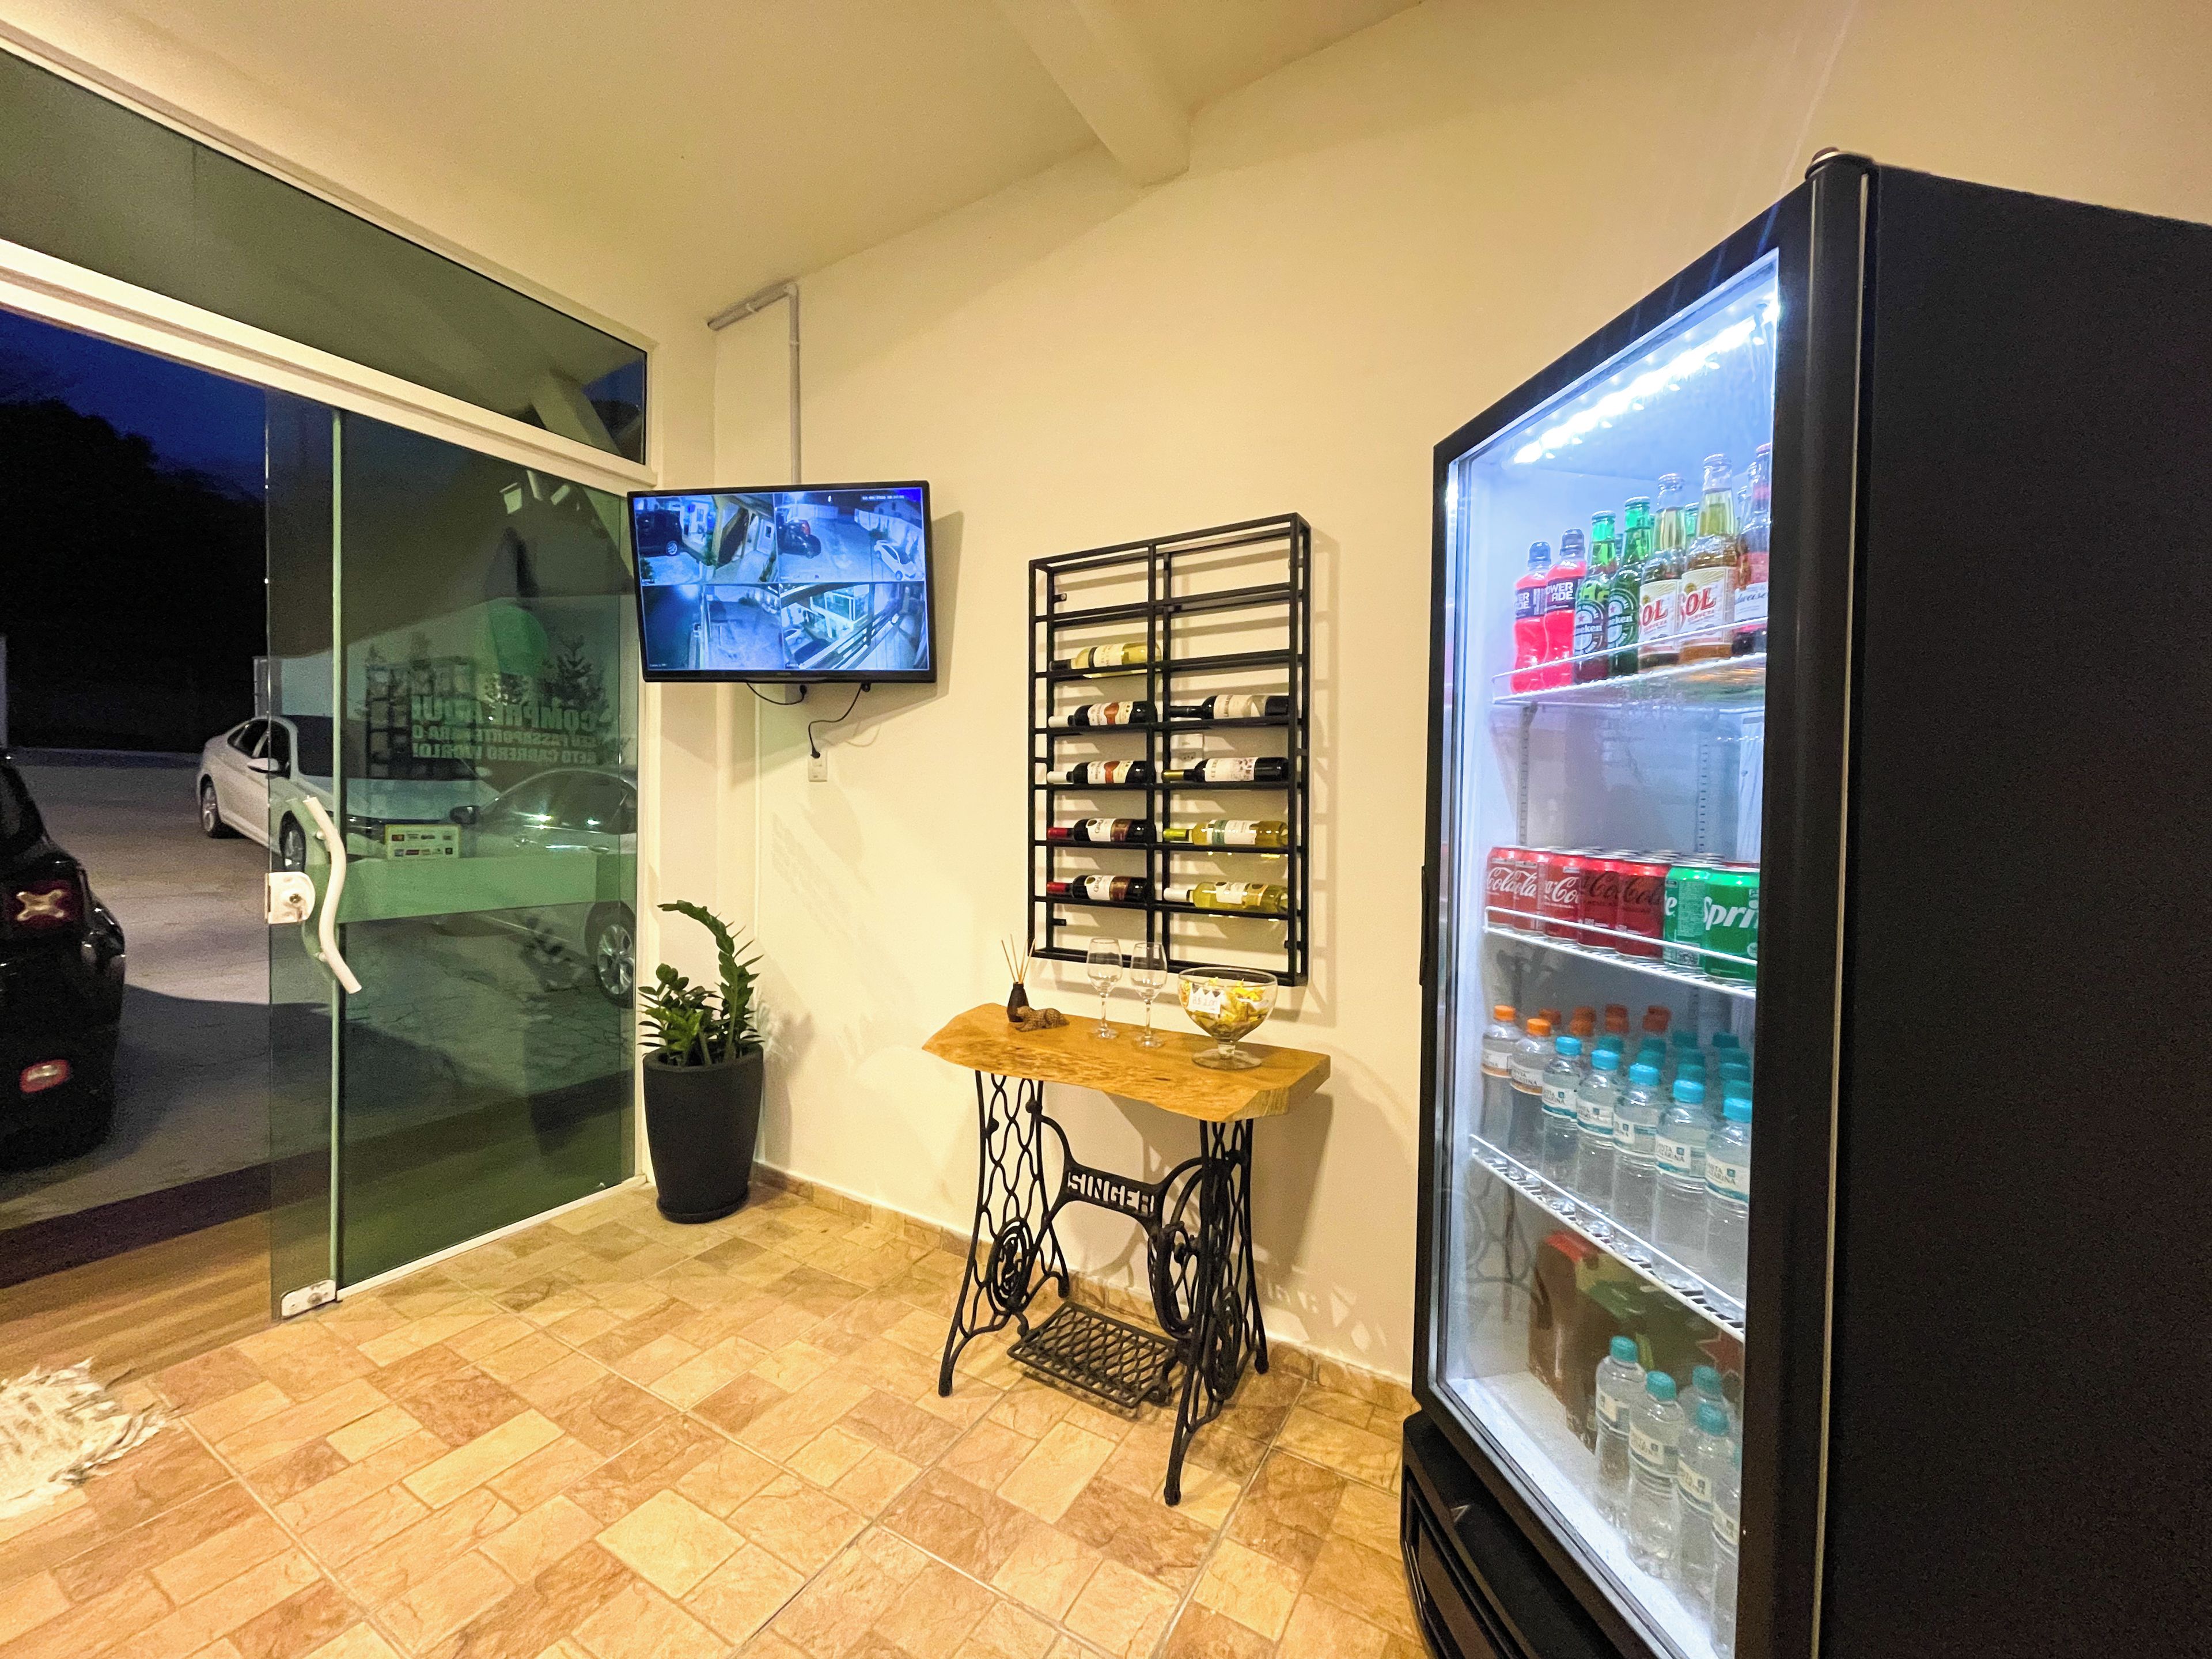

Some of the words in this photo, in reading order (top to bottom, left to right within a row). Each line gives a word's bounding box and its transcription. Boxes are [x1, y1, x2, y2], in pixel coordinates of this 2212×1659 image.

[1551, 591, 1574, 601] ADE
[1703, 896, 1759, 931] Spri
[1067, 1172, 1155, 1214] SINGER
